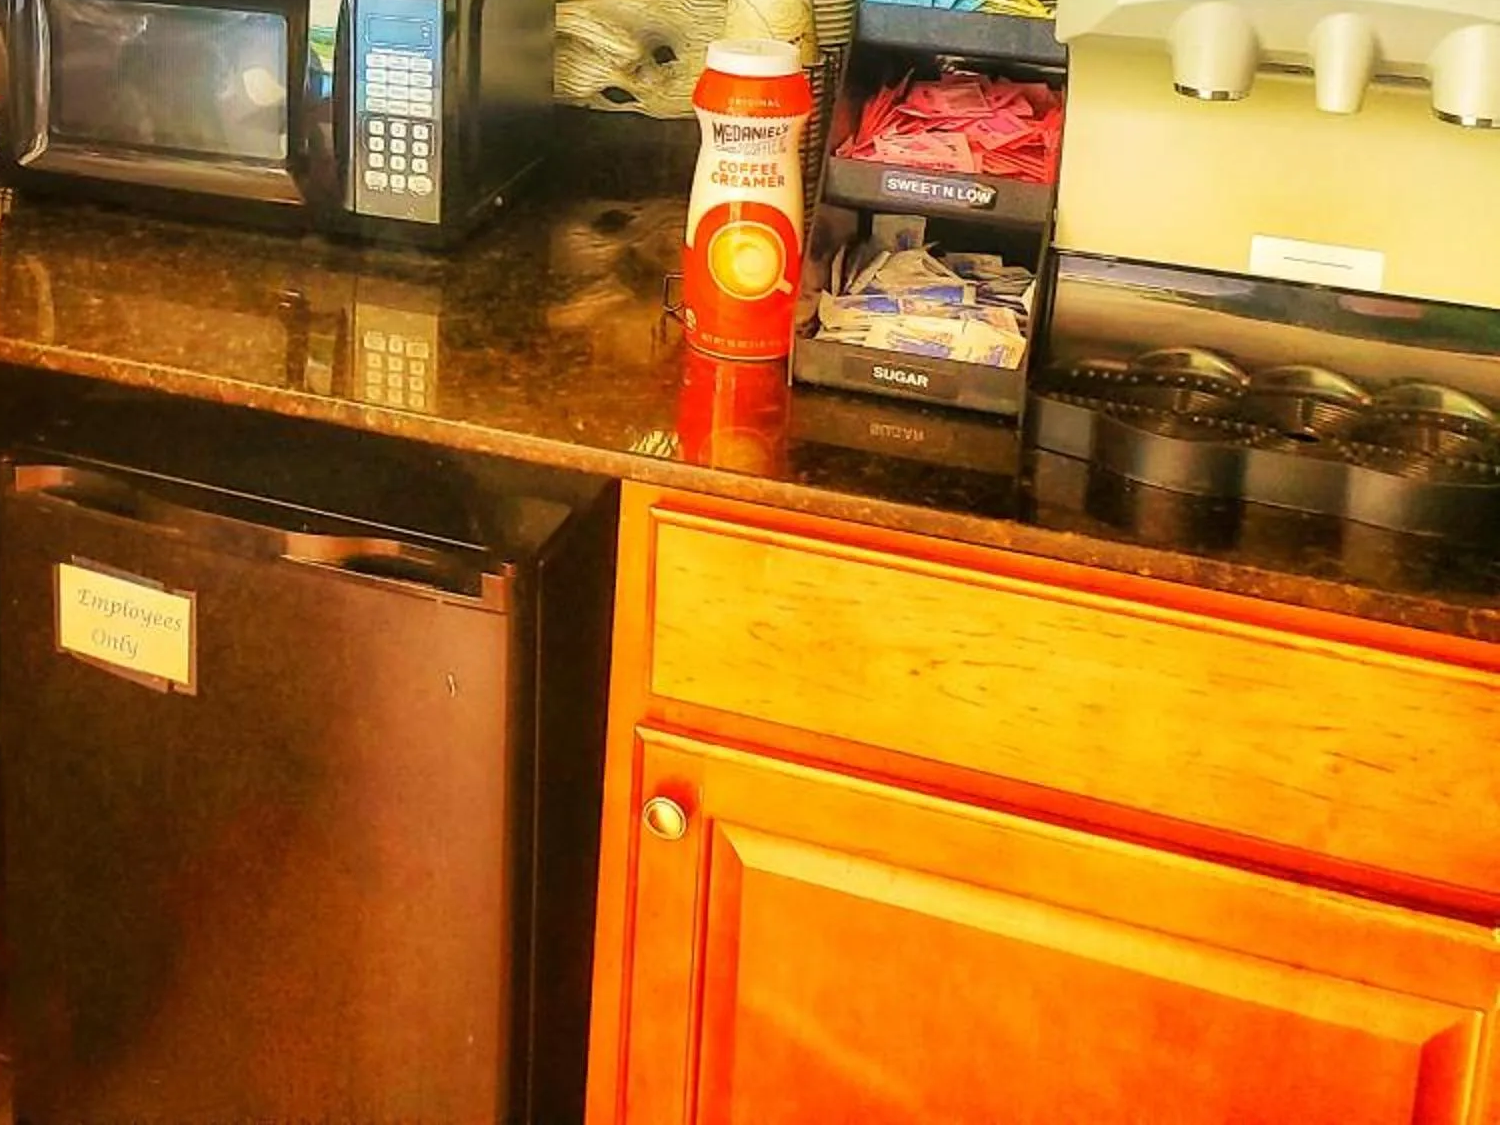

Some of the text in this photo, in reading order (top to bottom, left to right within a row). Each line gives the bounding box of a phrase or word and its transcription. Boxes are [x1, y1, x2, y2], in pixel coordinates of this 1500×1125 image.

[710, 171, 786, 188] CREAMER
[718, 159, 779, 176] COFFEE
[886, 177, 994, 205] SWEET N LOW
[872, 365, 930, 388] SUGAR
[77, 588, 182, 632] Employees
[91, 629, 139, 660] Only
